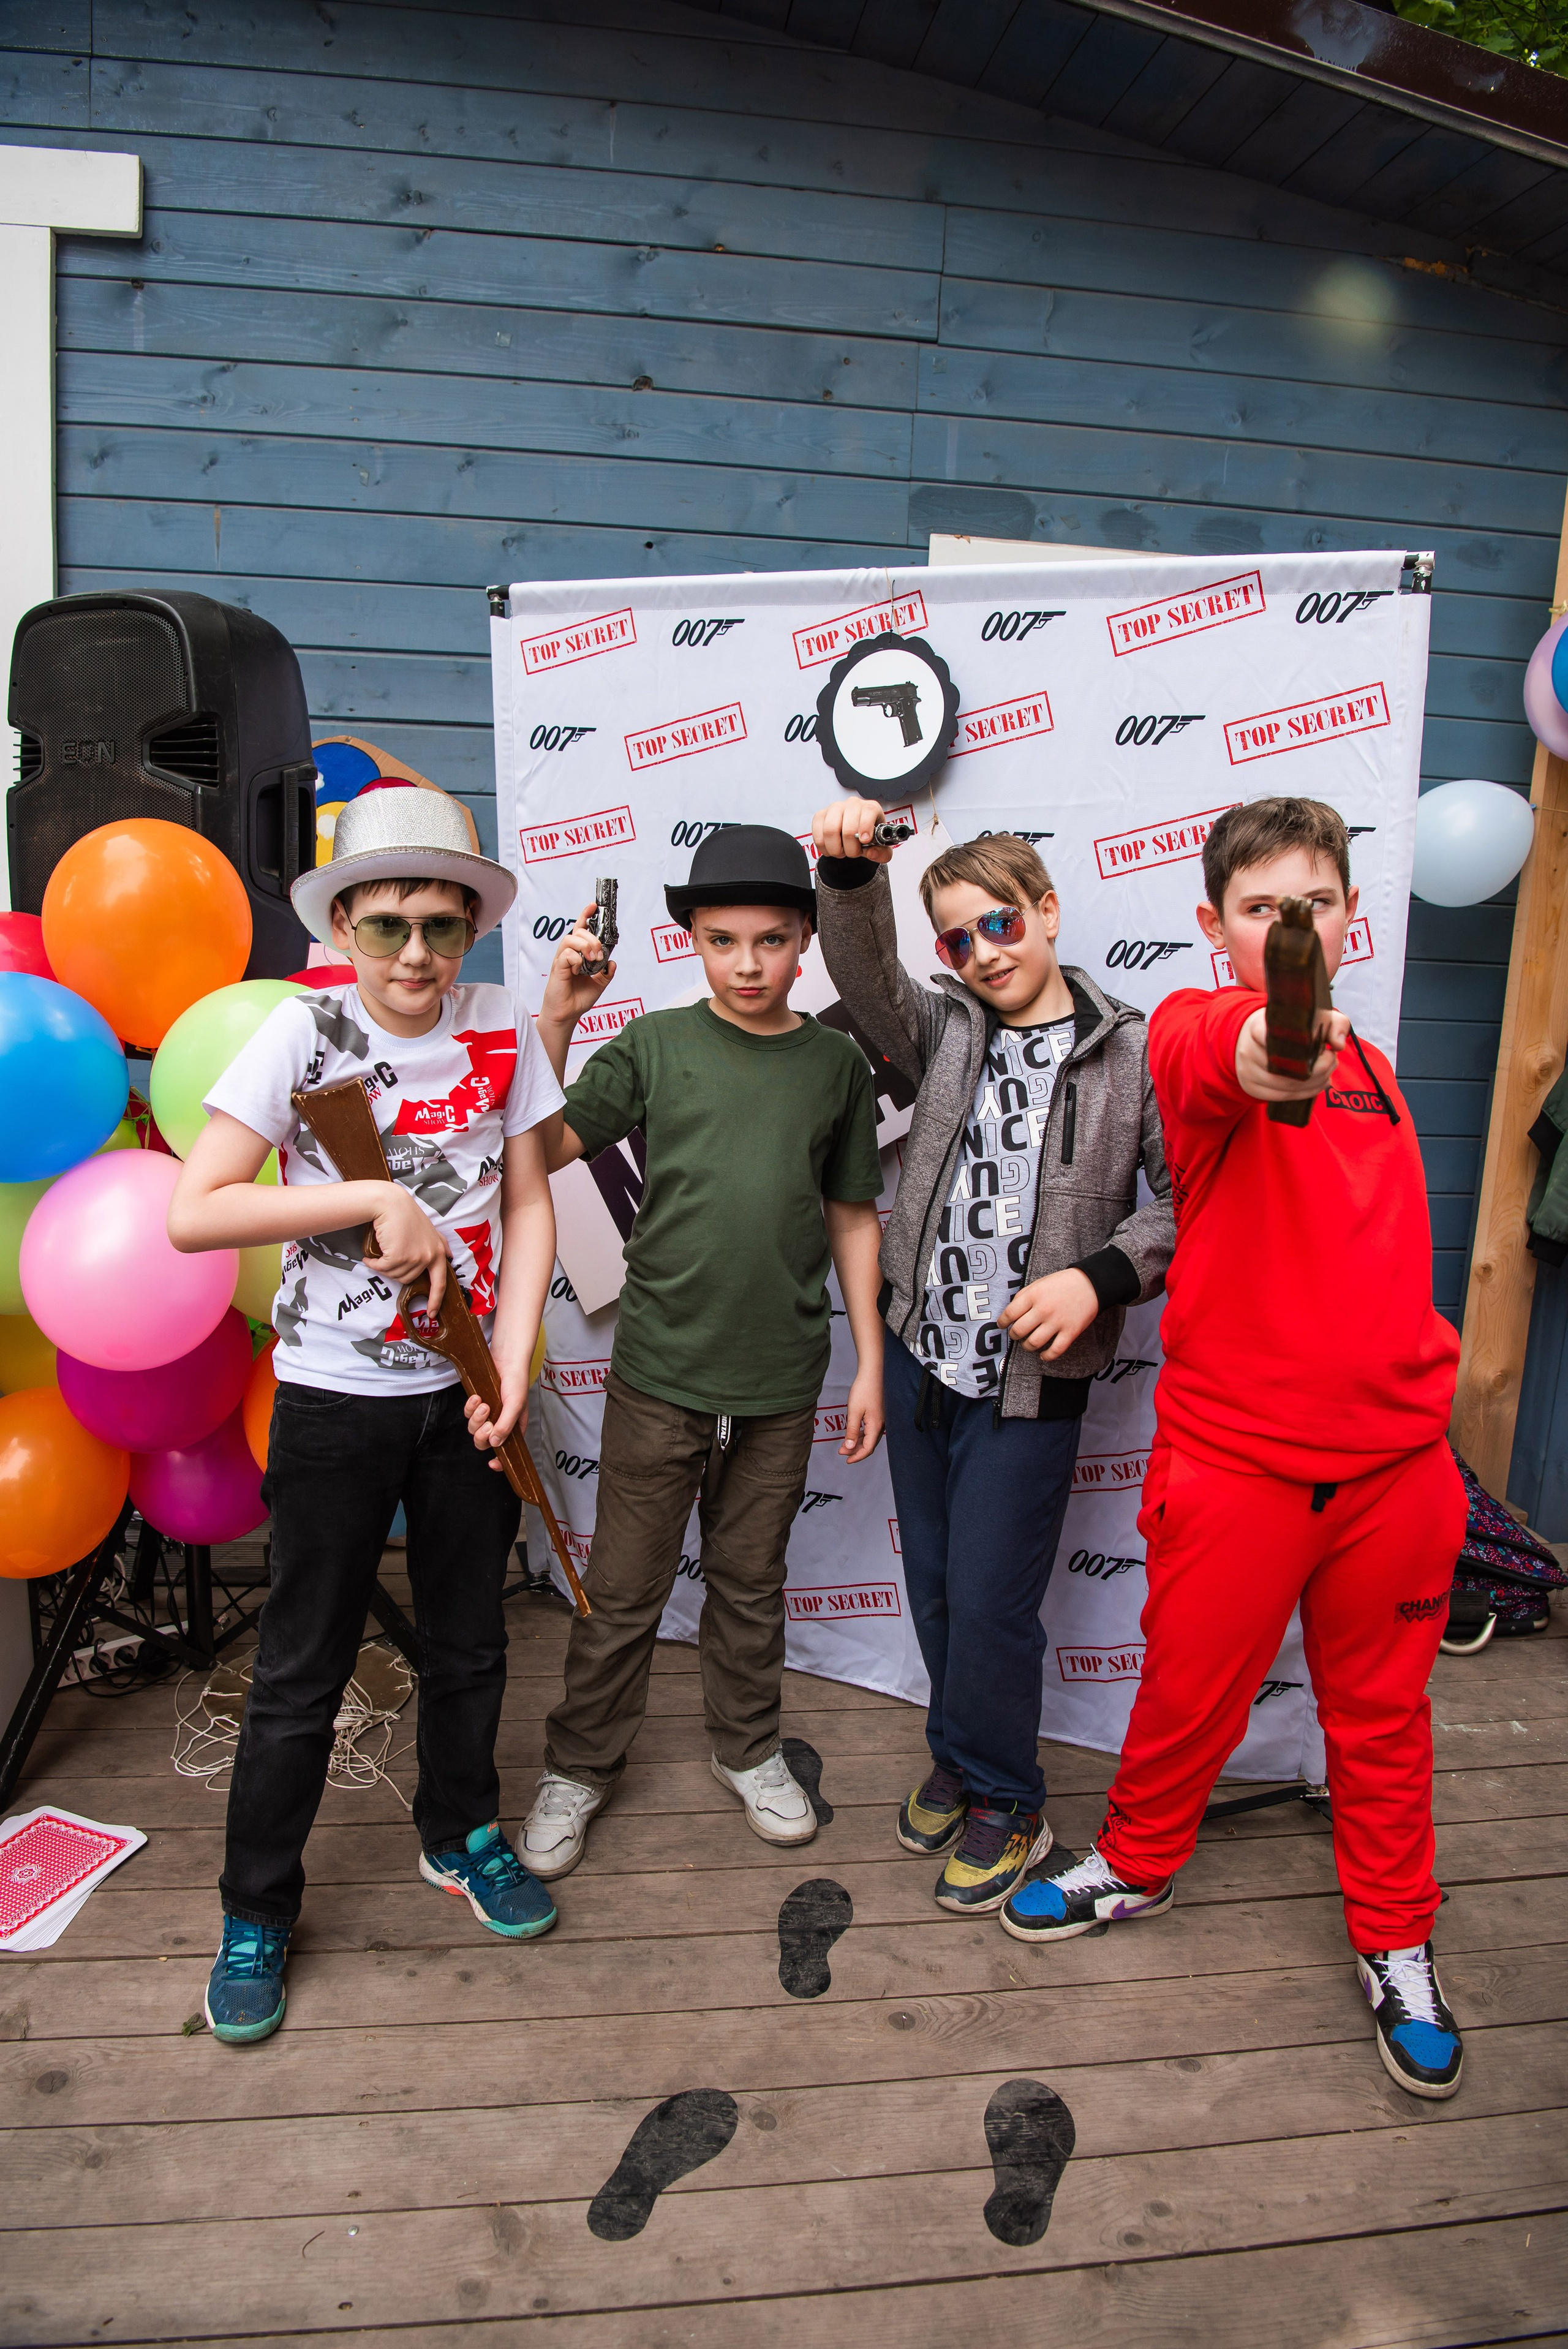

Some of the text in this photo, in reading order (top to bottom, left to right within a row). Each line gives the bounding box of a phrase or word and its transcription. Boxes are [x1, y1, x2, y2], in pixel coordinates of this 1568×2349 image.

[1118, 584, 1254, 643] TOP SECRET
[1295, 592, 1367, 624] 007
[673, 619, 725, 647] 007
[802, 601, 918, 657] TOP SECRET
[982, 611, 1042, 641] 007
[529, 619, 628, 664] TOP SECRET
[633, 714, 738, 760] TOP SECRET
[784, 715, 818, 742] 00
[964, 703, 1044, 743] SECRET
[1115, 715, 1181, 745] 007
[1235, 695, 1379, 752] TOP SECRET
[530, 725, 578, 752] 007
[527, 816, 627, 853] TOP SECRET
[1104, 821, 1215, 867] TOP SECR
[659, 931, 692, 952] TOP
[1106, 940, 1168, 970] 007
[578, 1008, 638, 1034] SECRET
[988, 1031, 1074, 1082] NICE
[479, 1174, 499, 1187] SHOW
[949, 1155, 1030, 1202] GUY
[556, 1450, 599, 1480] 007
[1068, 1549, 1125, 1580] 007
[790, 1591, 894, 1613] TOP SECRET
[1065, 1655, 1102, 1673] TOP
